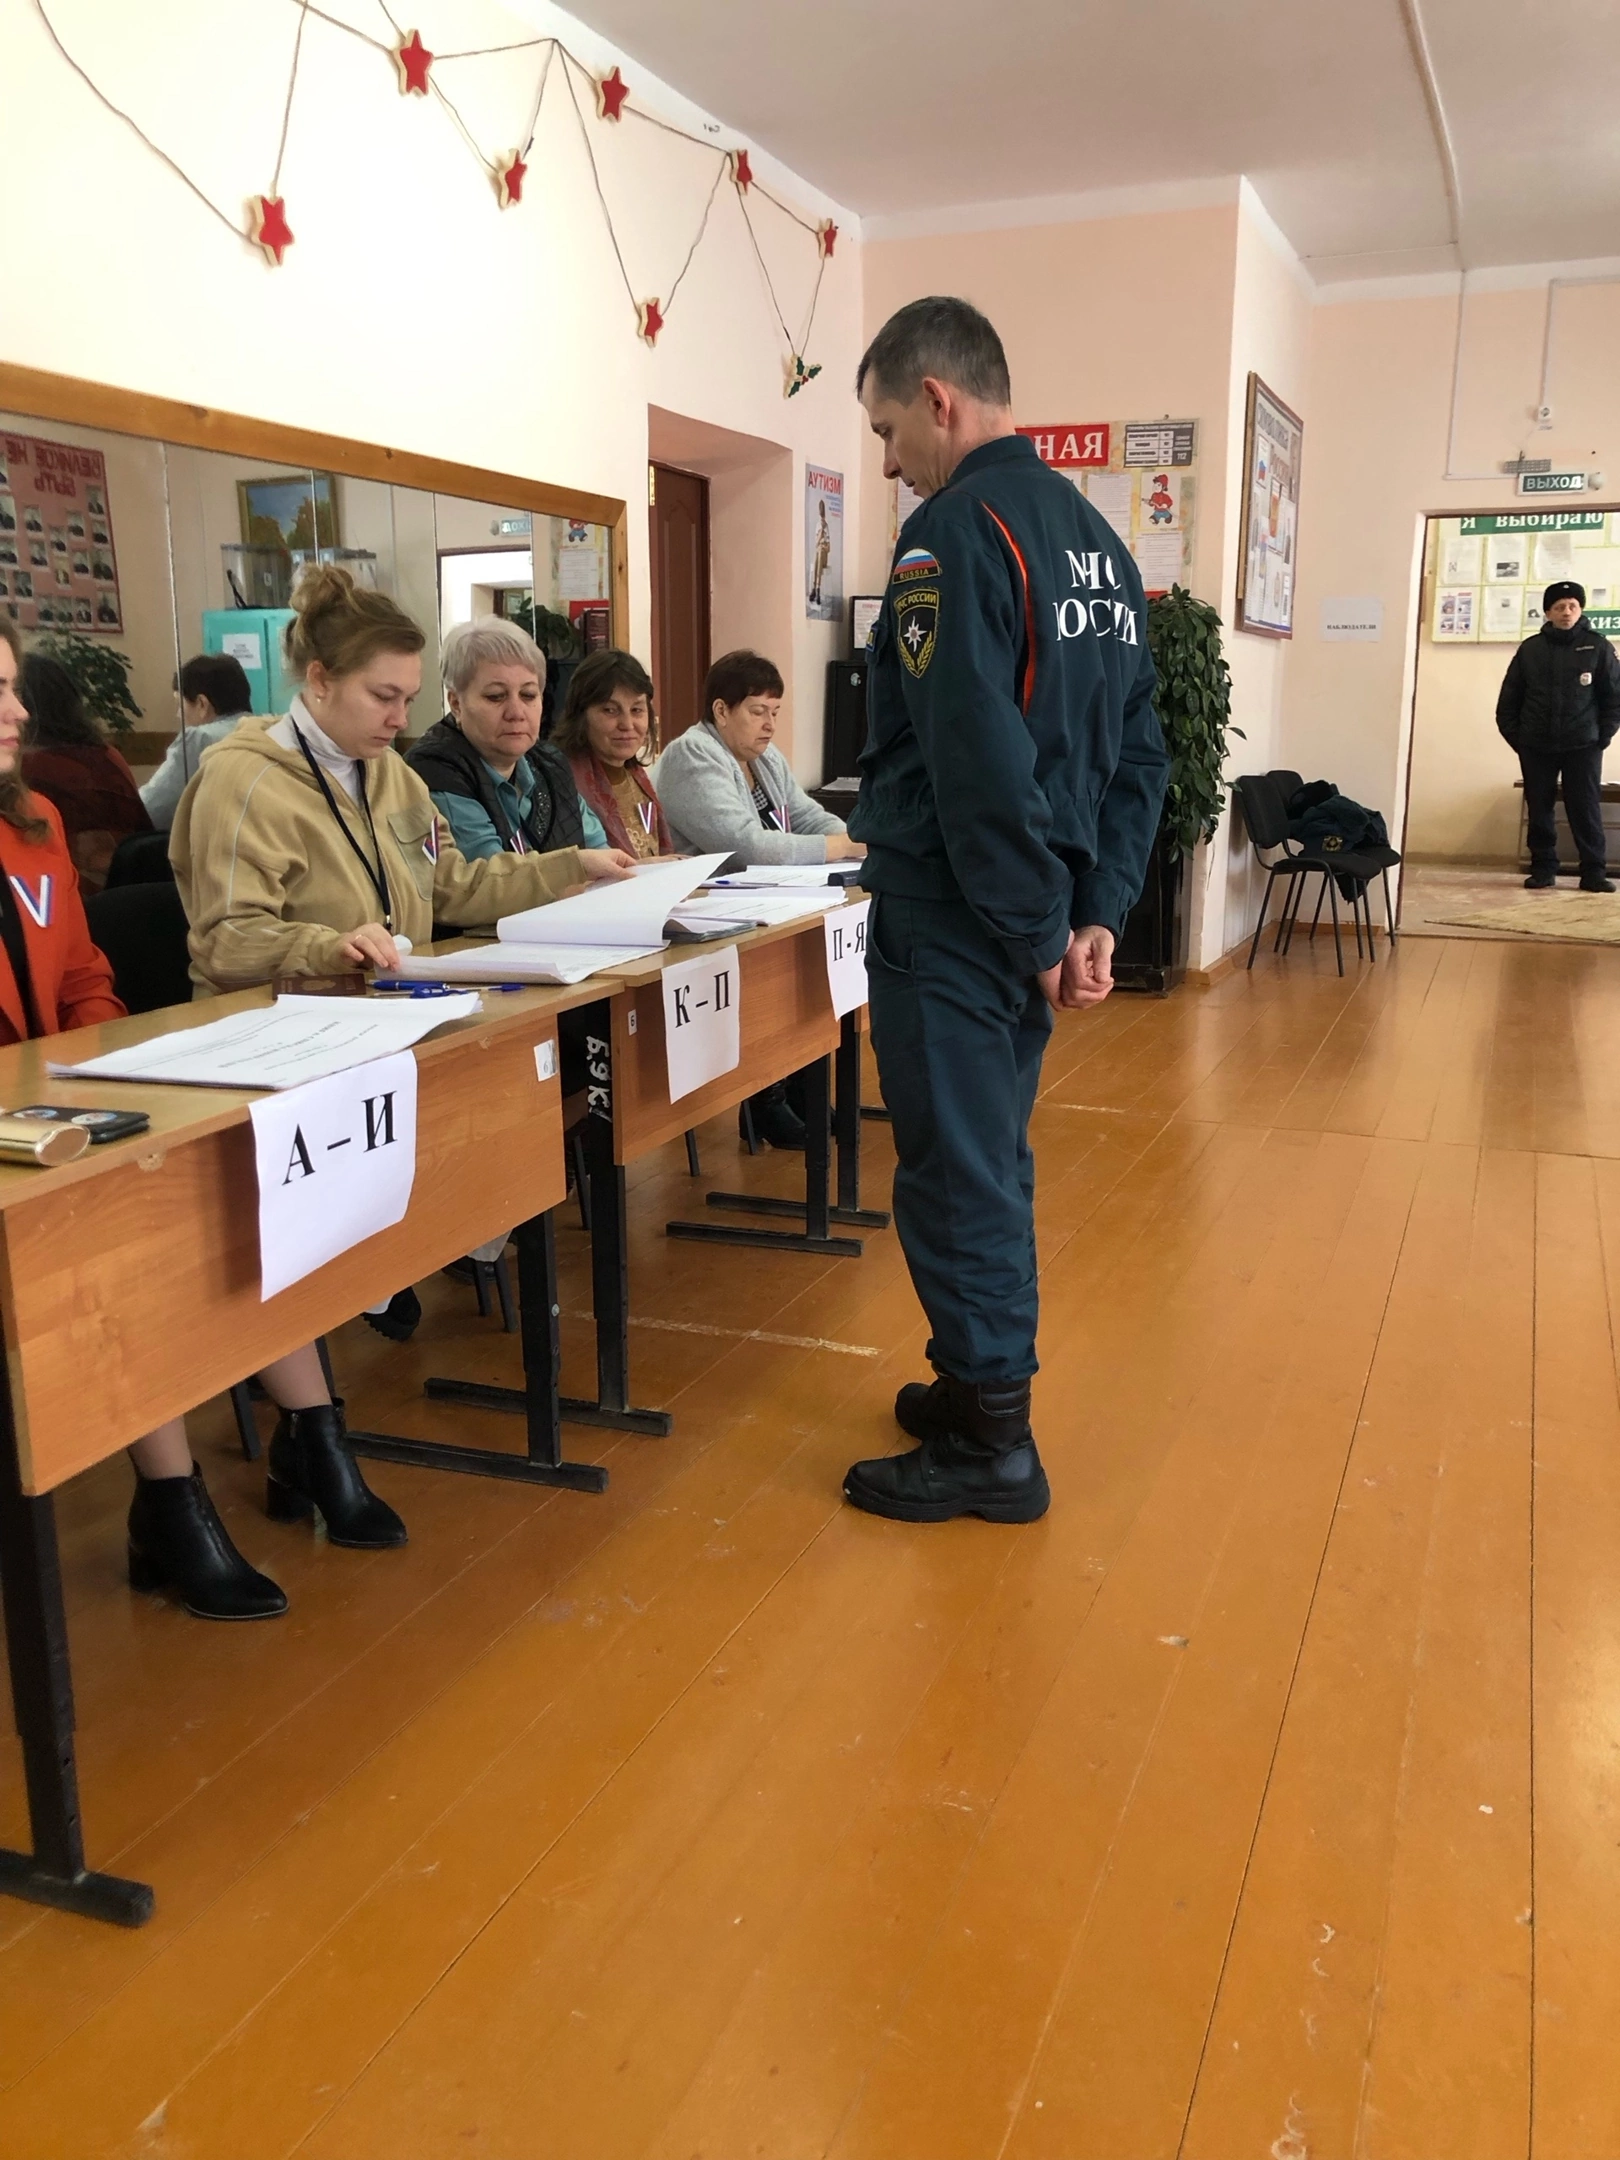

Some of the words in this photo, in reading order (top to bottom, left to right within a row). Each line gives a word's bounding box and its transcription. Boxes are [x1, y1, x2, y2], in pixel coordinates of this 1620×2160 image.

[808, 471, 841, 495] АУТИЗМ
[1526, 475, 1584, 490] ВЫХОД
[900, 569, 929, 580] RUSSIA
[908, 593, 937, 604] РОССИИ
